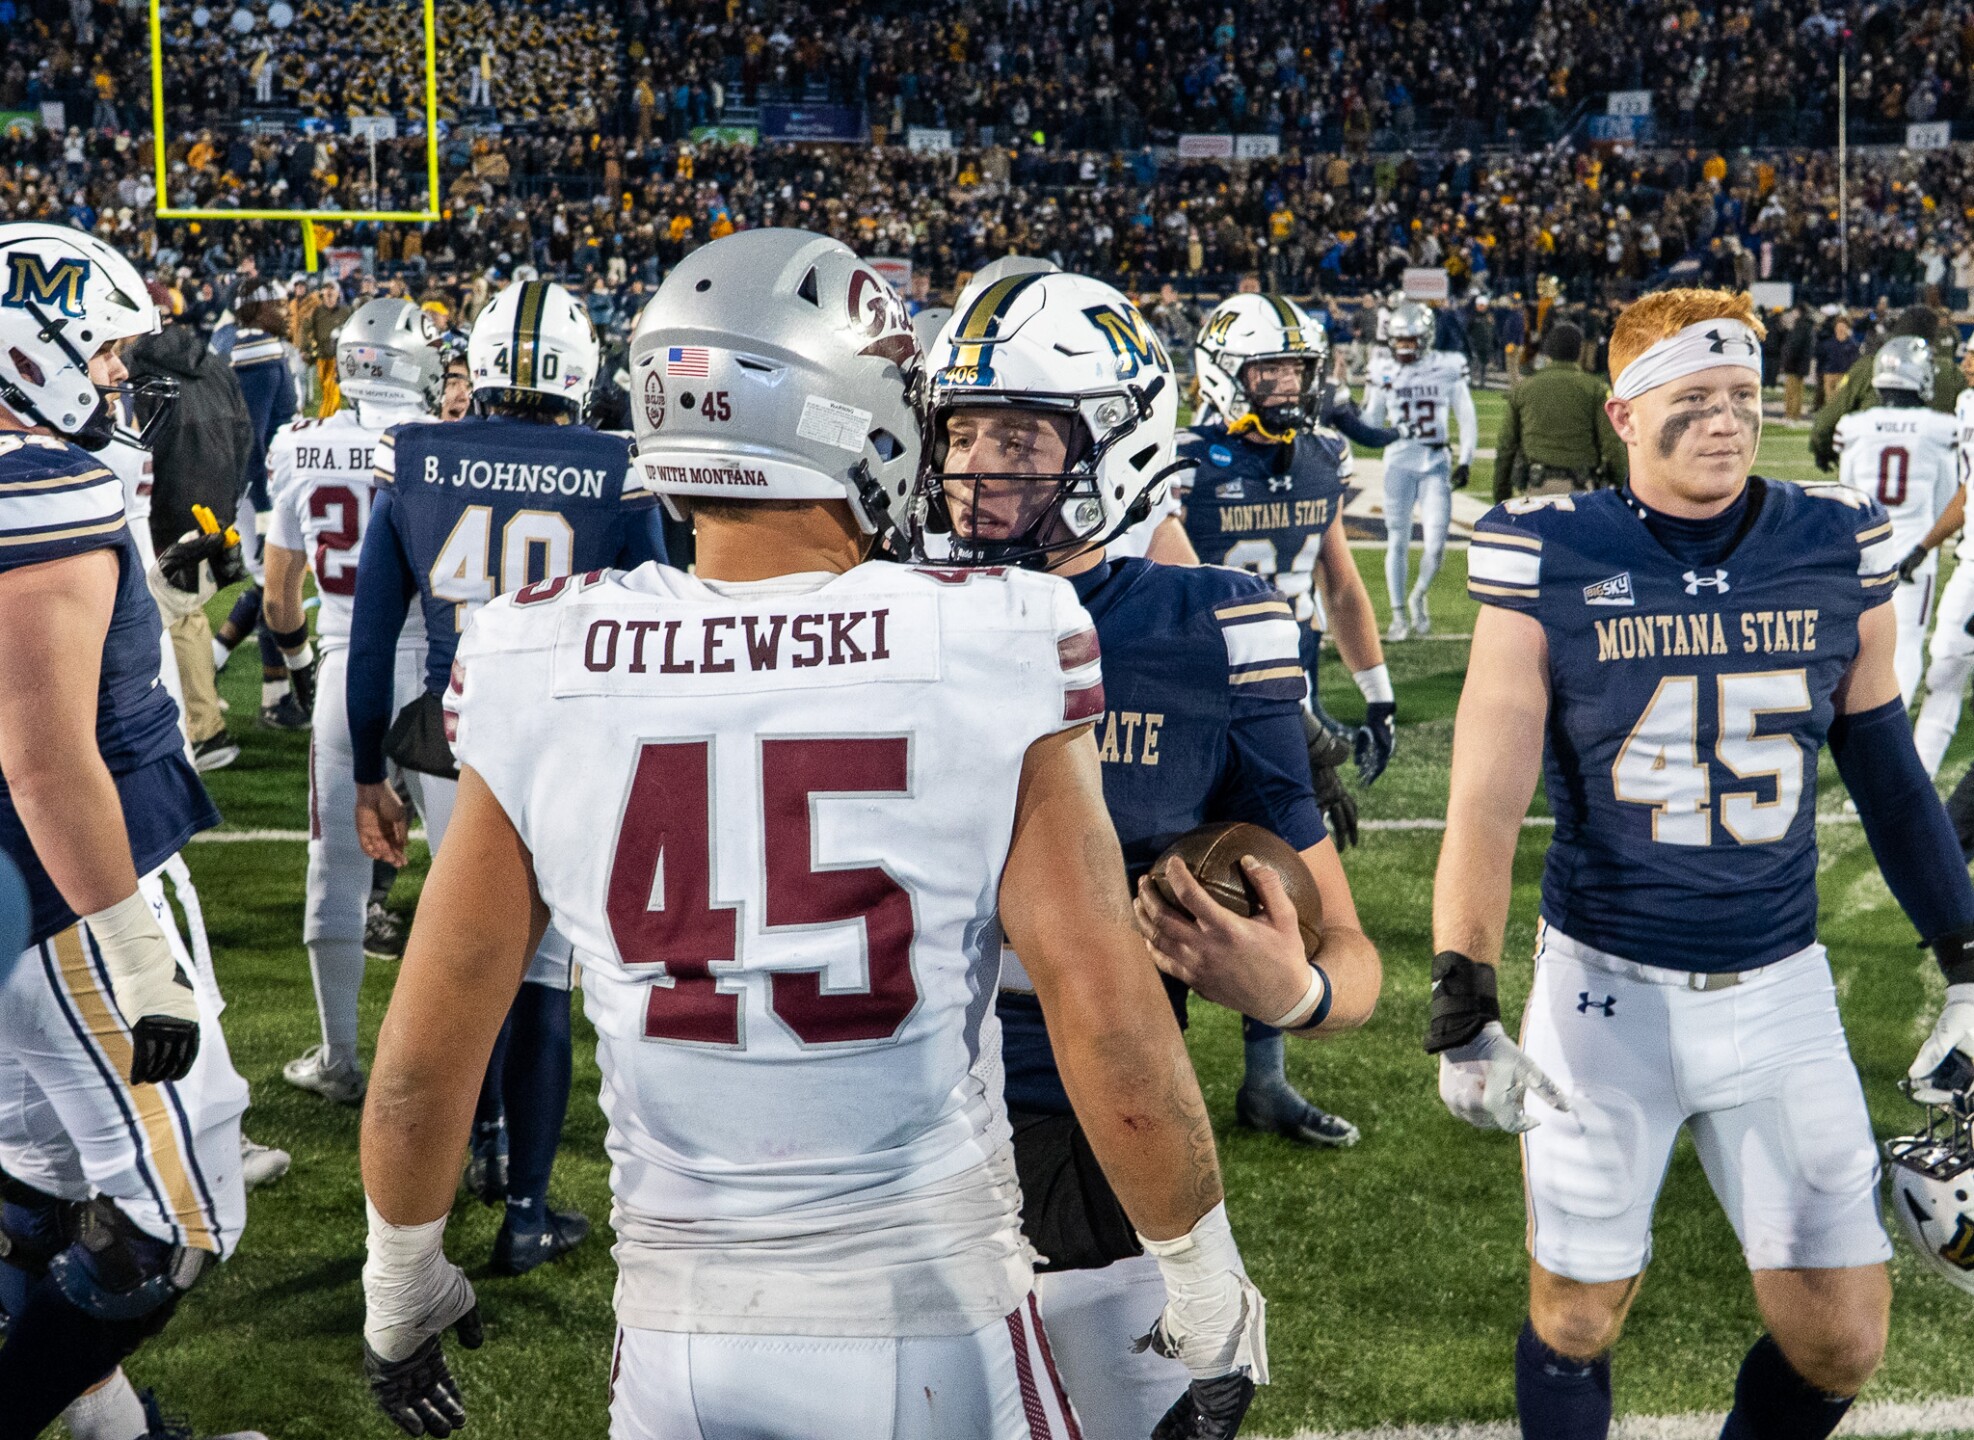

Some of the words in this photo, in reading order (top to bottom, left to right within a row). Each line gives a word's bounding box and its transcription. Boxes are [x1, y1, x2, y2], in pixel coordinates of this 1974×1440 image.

[3, 250, 90, 317] M
[1081, 303, 1169, 381] M
[1201, 310, 1241, 346] M
[945, 367, 979, 386] 406
[701, 391, 731, 422] 45
[296, 447, 342, 470] BRA.
[424, 456, 444, 486] B.
[451, 458, 606, 499] JOHNSON
[645, 464, 656, 480] UP
[657, 465, 688, 483] WITH
[689, 467, 769, 487] MONTANA
[1877, 446, 1910, 506] 0
[1219, 502, 1290, 533] MONTANA
[1294, 498, 1328, 526] STATE
[429, 505, 574, 634] 40
[584, 607, 890, 674] OTLEWSKI
[1594, 612, 1728, 662] MONTANA
[1741, 608, 1818, 654] STATE
[1093, 710, 1165, 766] ATE
[1611, 668, 1813, 847] 45
[604, 731, 922, 1051] 45
